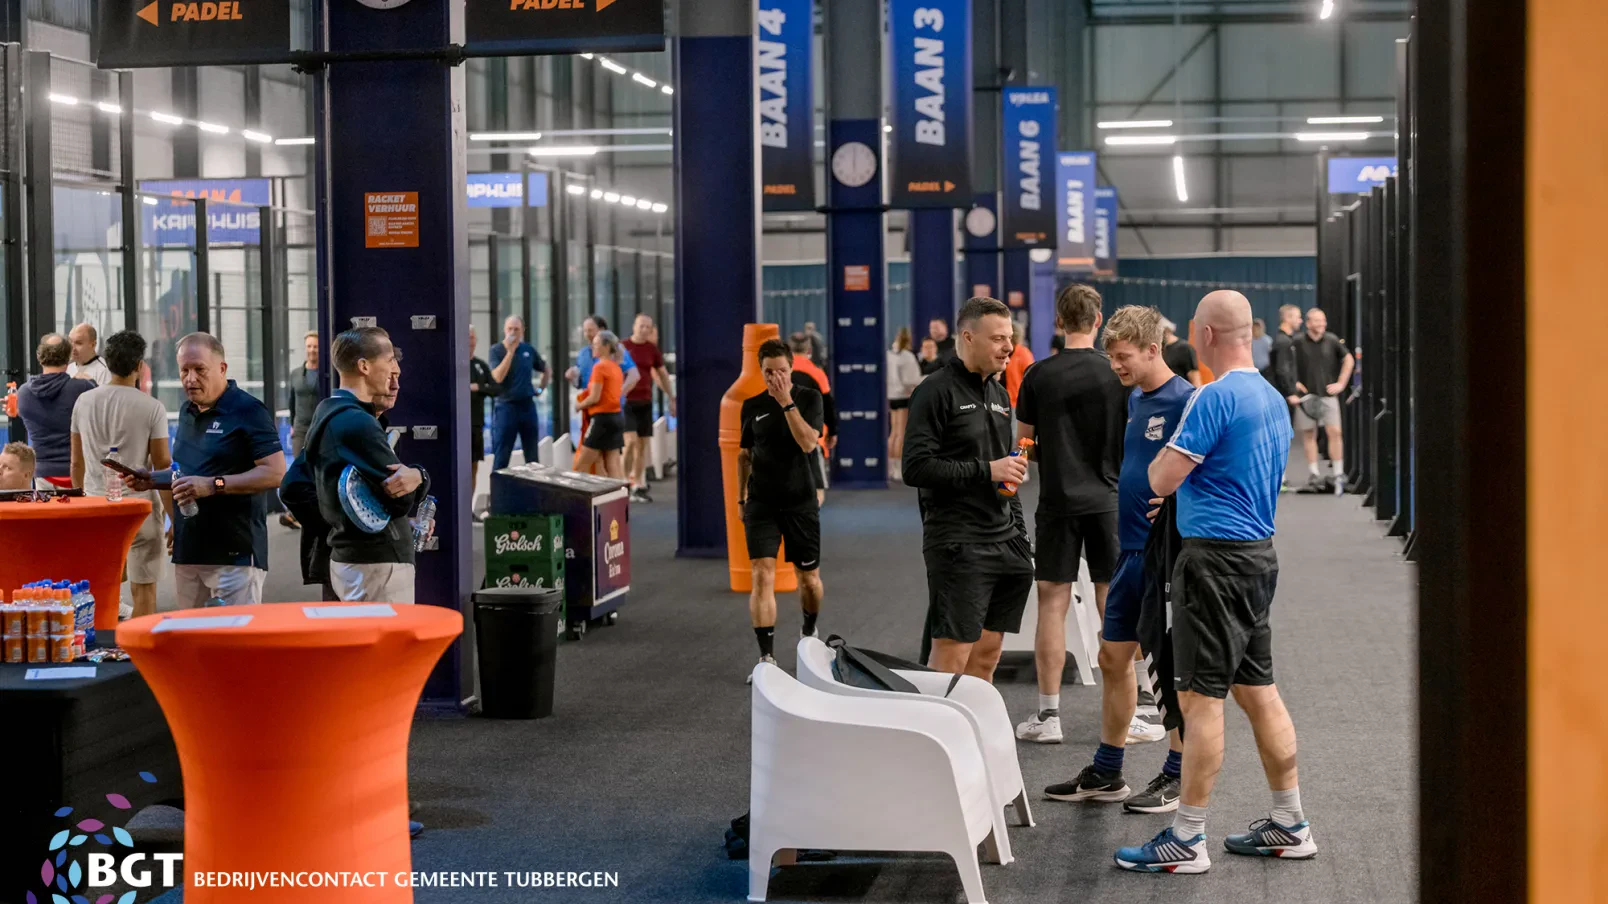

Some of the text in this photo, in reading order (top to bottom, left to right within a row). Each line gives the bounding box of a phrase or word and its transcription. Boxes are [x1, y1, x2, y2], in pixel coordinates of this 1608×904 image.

[170, 1, 243, 22] PADEL
[758, 8, 788, 148] BAAN 4
[912, 7, 946, 146] BAAN 3
[1018, 119, 1040, 138] 6
[1018, 140, 1042, 210] BAAN
[368, 194, 406, 204] RACKET
[368, 203, 416, 213] VERHUUR
[1066, 190, 1085, 244] BAAN
[494, 533, 543, 555] Grolsch
